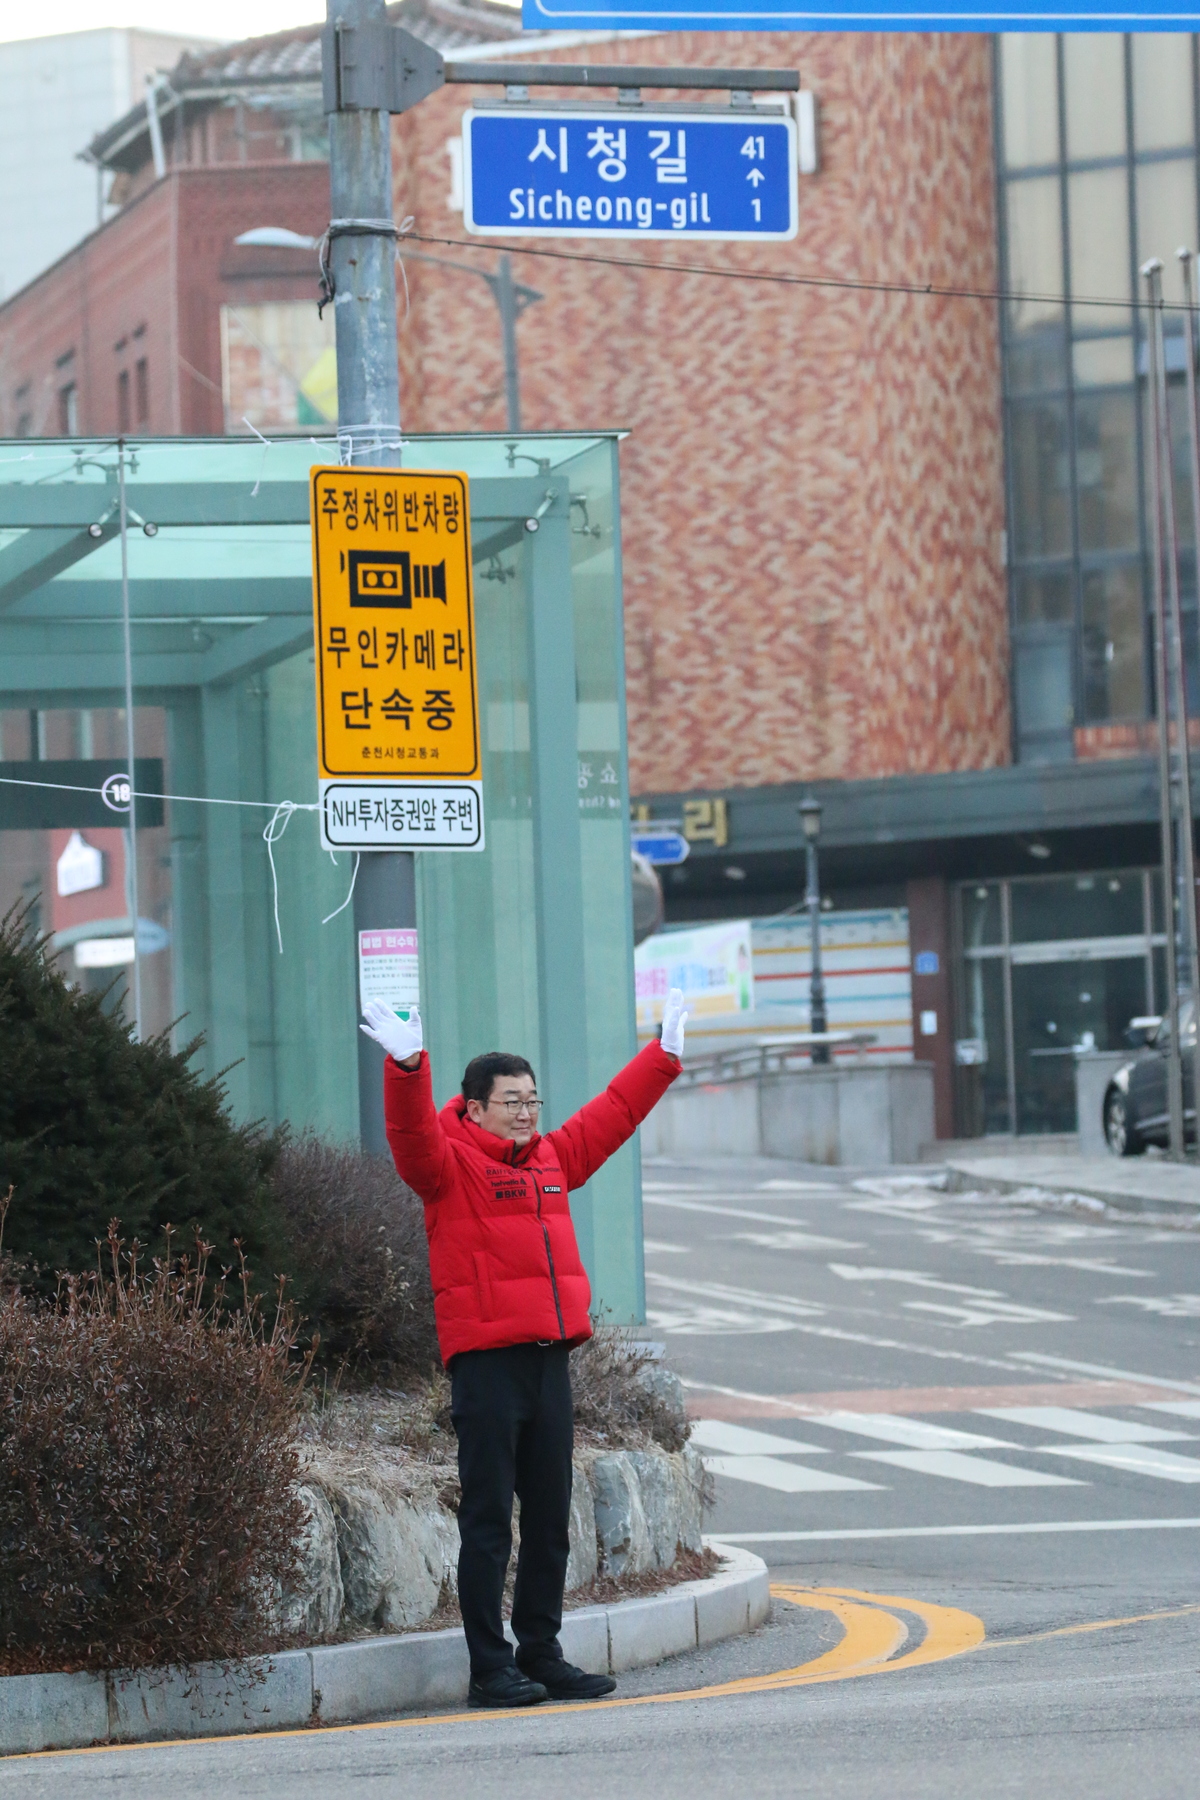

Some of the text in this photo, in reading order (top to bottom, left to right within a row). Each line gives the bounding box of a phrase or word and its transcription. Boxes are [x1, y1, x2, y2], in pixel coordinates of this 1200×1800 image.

[528, 126, 688, 184] 시청길
[740, 136, 765, 160] 41
[509, 188, 711, 230] Sicheong-gil
[751, 198, 761, 222] 1
[322, 488, 459, 534] 주정차위반차량
[327, 626, 465, 671] 무인카메라
[341, 687, 455, 731] 단속중
[362, 746, 440, 760] 춘천시청교통과
[110, 783, 131, 802] 18
[332, 798, 473, 832] NH투자증권앞 주변
[504, 1189, 527, 1198] BKW
